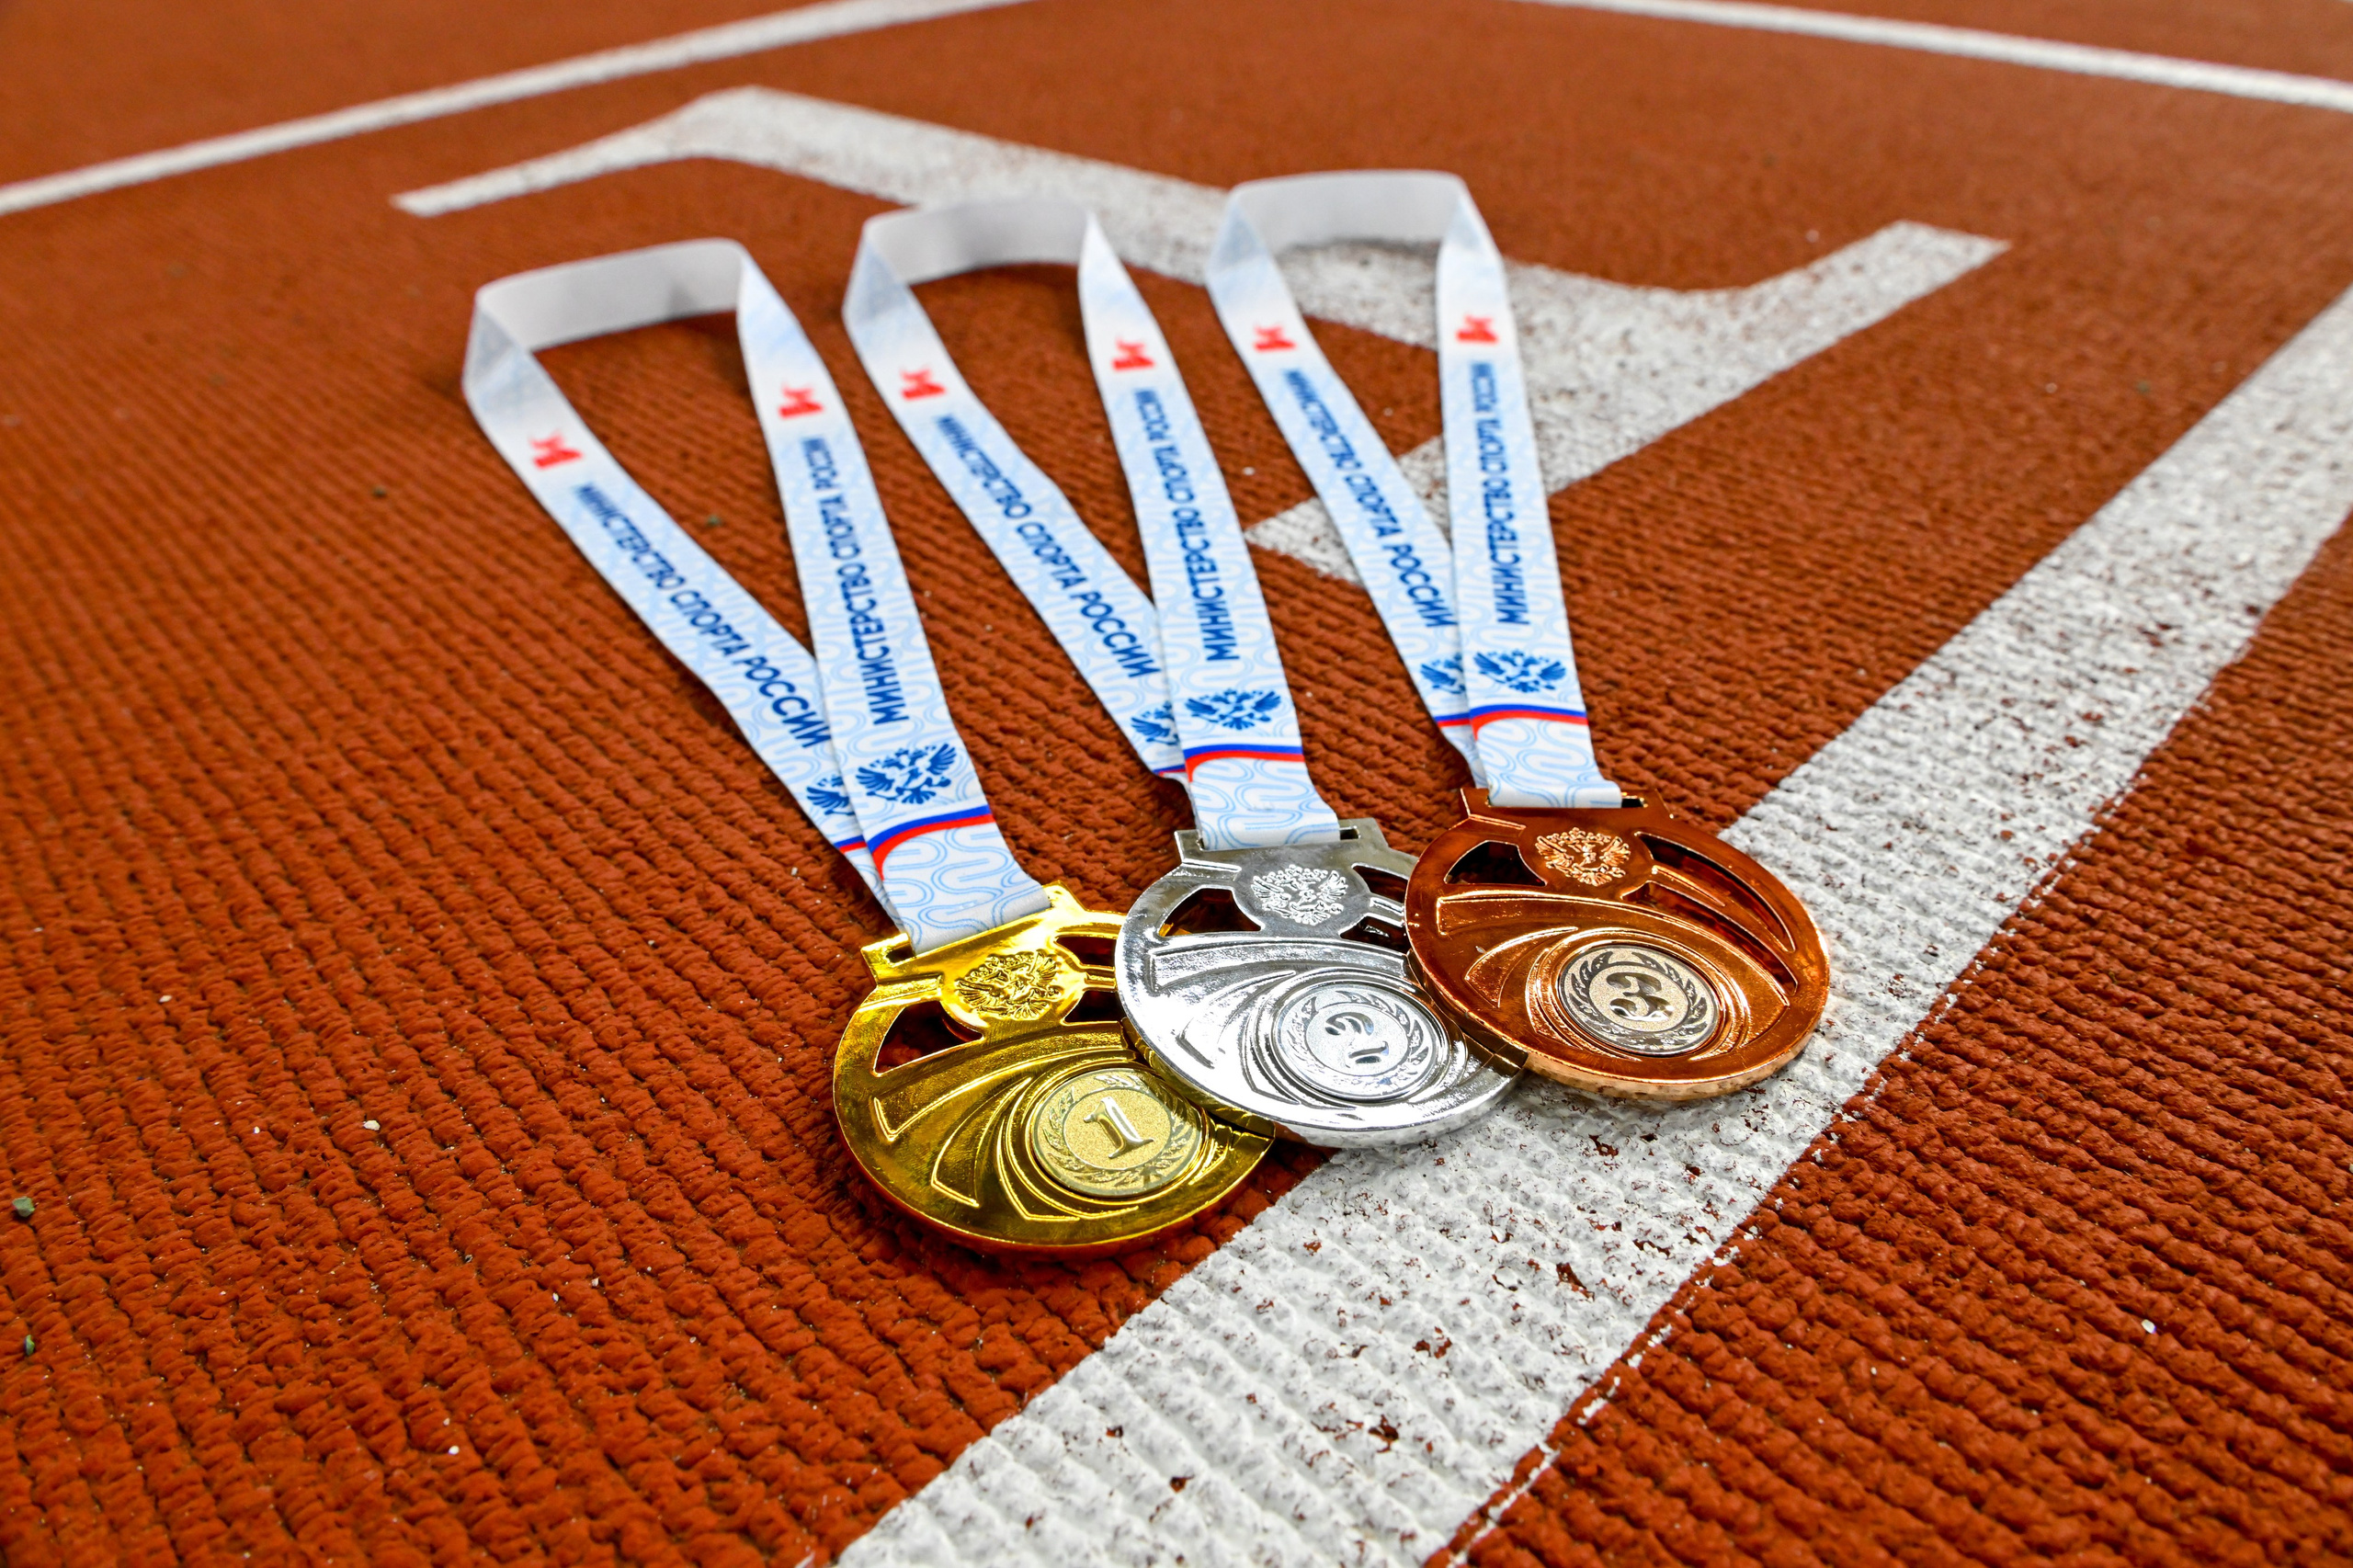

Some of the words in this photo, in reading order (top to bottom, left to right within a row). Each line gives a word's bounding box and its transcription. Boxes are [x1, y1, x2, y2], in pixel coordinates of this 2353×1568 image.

[1154, 446, 1196, 503] СПОРТА
[1286, 369, 1361, 471] МИНИСТЕРСТВО
[1347, 473, 1401, 539] СПОРТА
[1383, 542, 1460, 628] РОССИИ
[1476, 417, 1509, 473] СПОРТА
[821, 494, 862, 560] СПОРТА
[938, 415, 1033, 520] МИНИСТЕРСТВО
[1017, 520, 1088, 589] СПОРТА
[1070, 590, 1163, 678] РОССИИ
[1483, 478, 1531, 626] МИНИСТЕРСТВО
[576, 484, 686, 589] МИНИСТЕРСТВО
[670, 590, 753, 656] СПОРТА
[733, 656, 831, 750] РОССИИ
[1174, 508, 1241, 663] МИНИСТЕРСТВО
[842, 562, 909, 725] МИНИСТЕРСТВО
[1324, 1010, 1391, 1069] 2
[1605, 971, 1675, 1022] 3
[1082, 1096, 1155, 1159] 1
